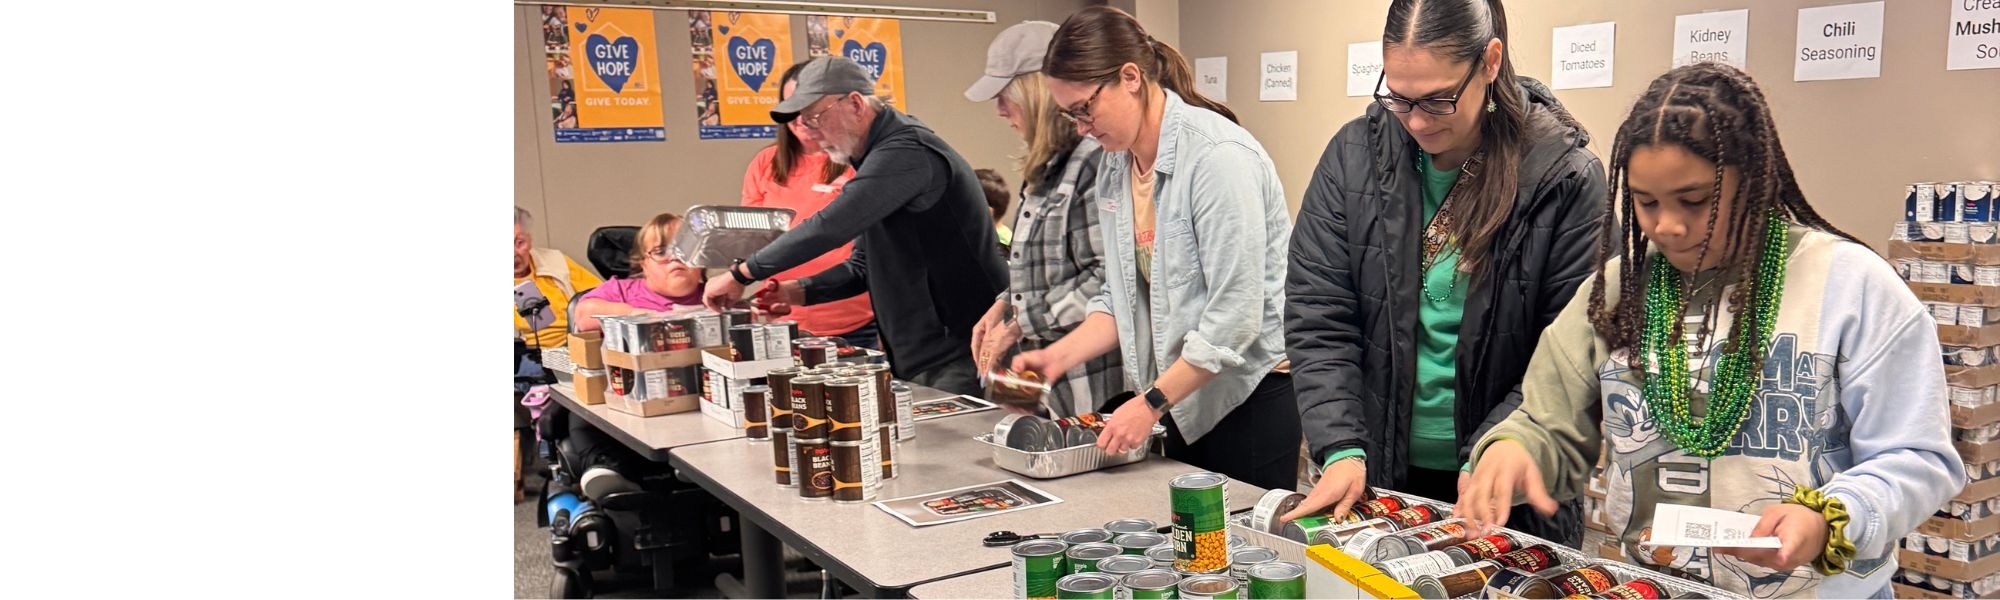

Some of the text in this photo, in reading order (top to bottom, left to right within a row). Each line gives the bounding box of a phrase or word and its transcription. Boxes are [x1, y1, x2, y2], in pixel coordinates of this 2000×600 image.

[1690, 29, 1731, 43] Kidney
[1823, 21, 1856, 37] Chili
[595, 44, 629, 59] GIVE
[736, 46, 767, 60] GIVE
[1570, 41, 1596, 53] Diced
[1800, 44, 1876, 61] Seasoning
[1976, 43, 2000, 59] So
[850, 48, 879, 62] GIVE
[1690, 50, 1728, 63] Beans
[597, 61, 631, 76] HOPE
[737, 63, 768, 77] HOPE
[1266, 64, 1291, 73] Chicken
[1351, 63, 1384, 76] Spaghet
[1561, 58, 1605, 72] Tomatoes
[585, 97, 611, 106] GIVE
[727, 96, 780, 105] GIVE TODA
[812, 455, 830, 463] BLAC
[812, 461, 831, 469] BEAN
